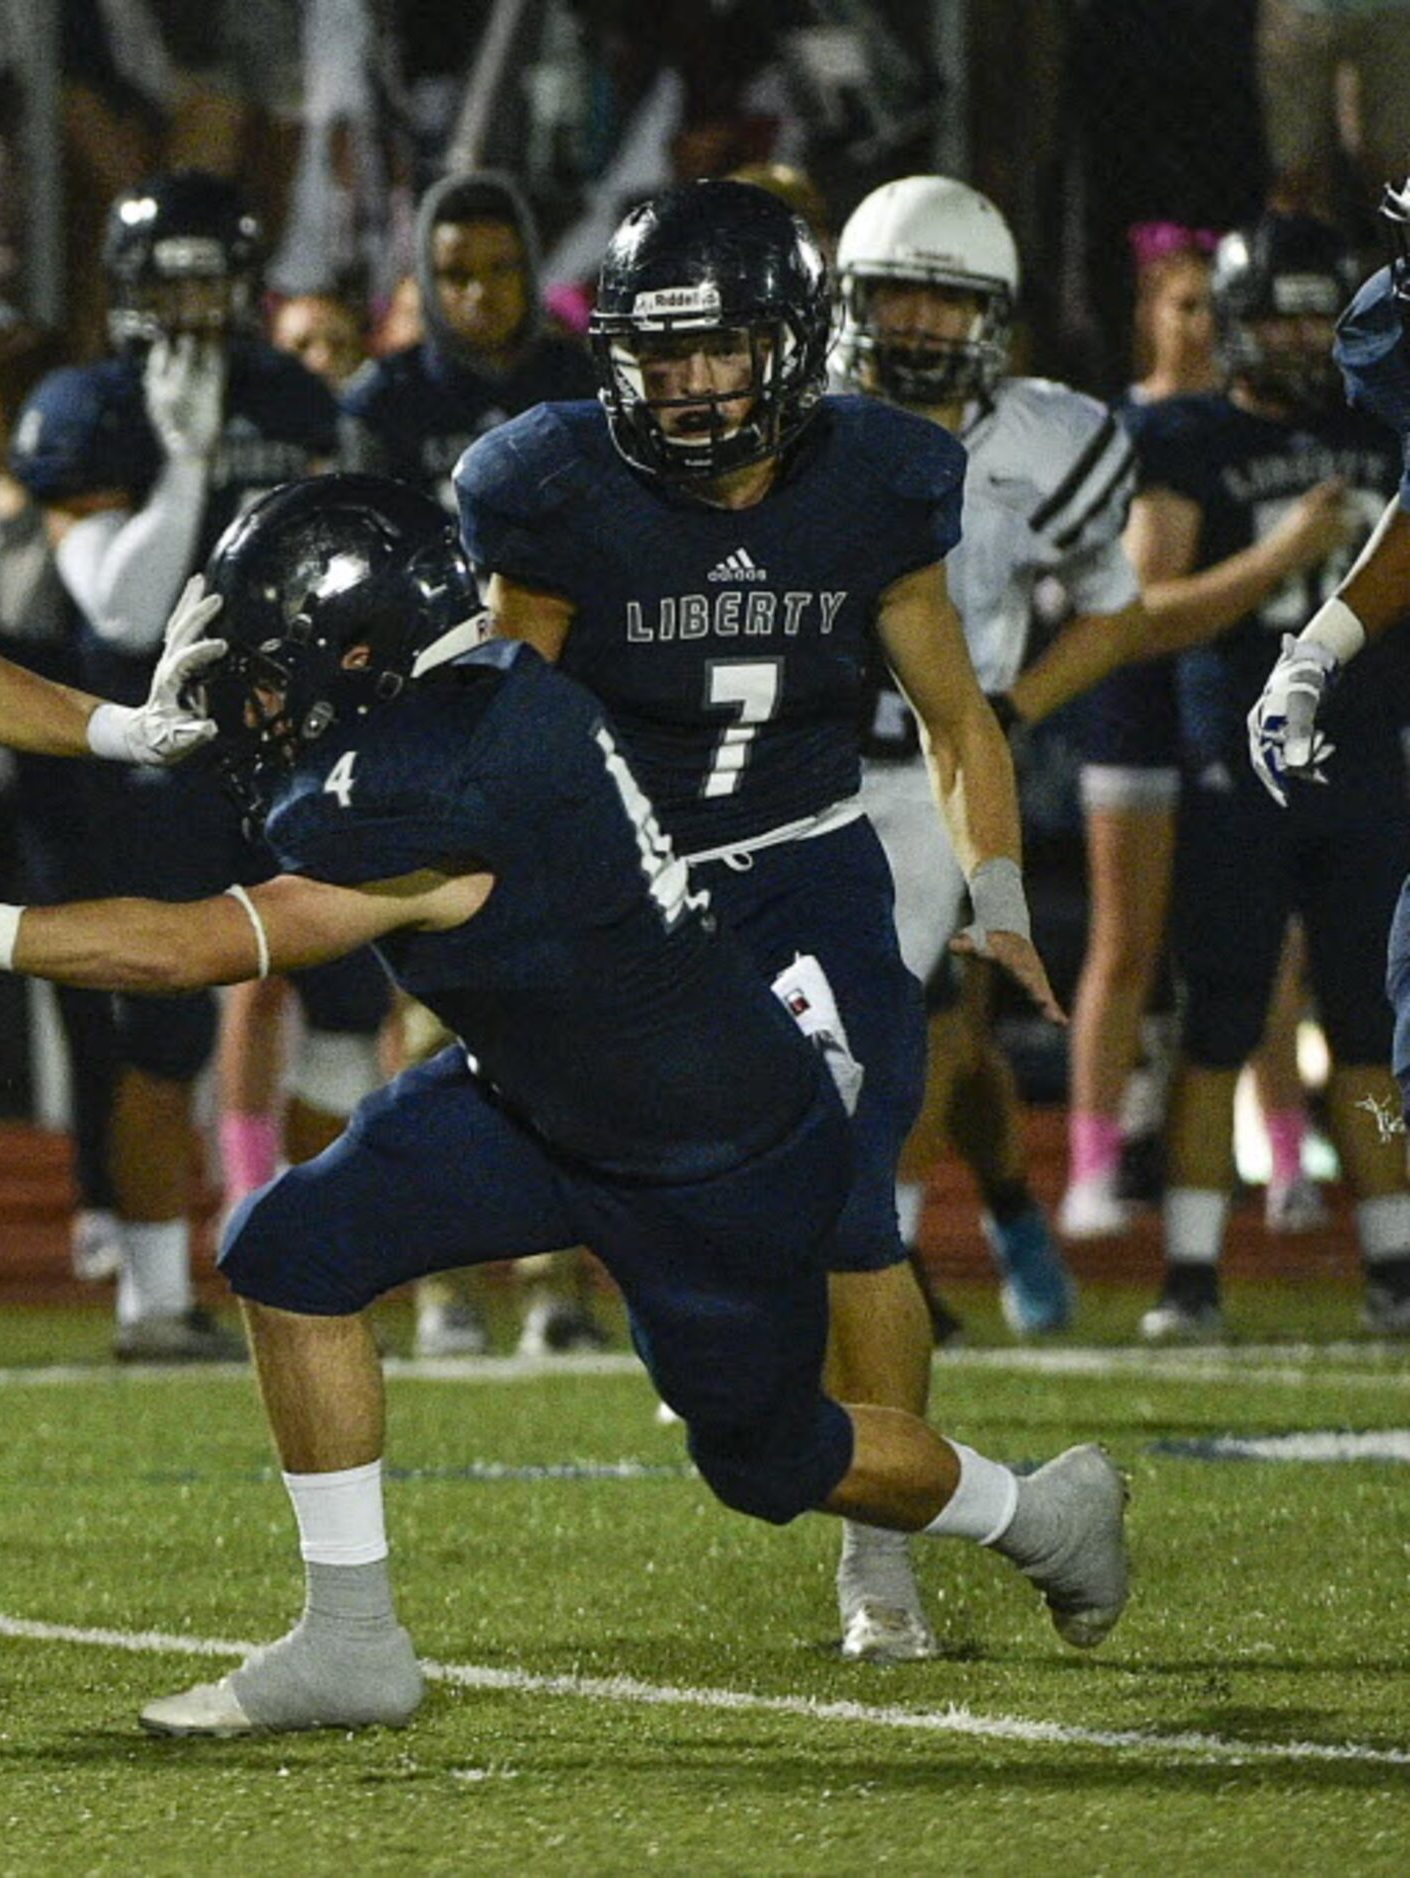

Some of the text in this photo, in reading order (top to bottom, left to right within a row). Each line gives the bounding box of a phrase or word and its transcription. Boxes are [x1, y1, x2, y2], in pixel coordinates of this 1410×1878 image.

[707, 568, 767, 582] adidas
[627, 591, 847, 642] LIBERTY
[703, 656, 784, 798] 7
[323, 750, 358, 808] 4
